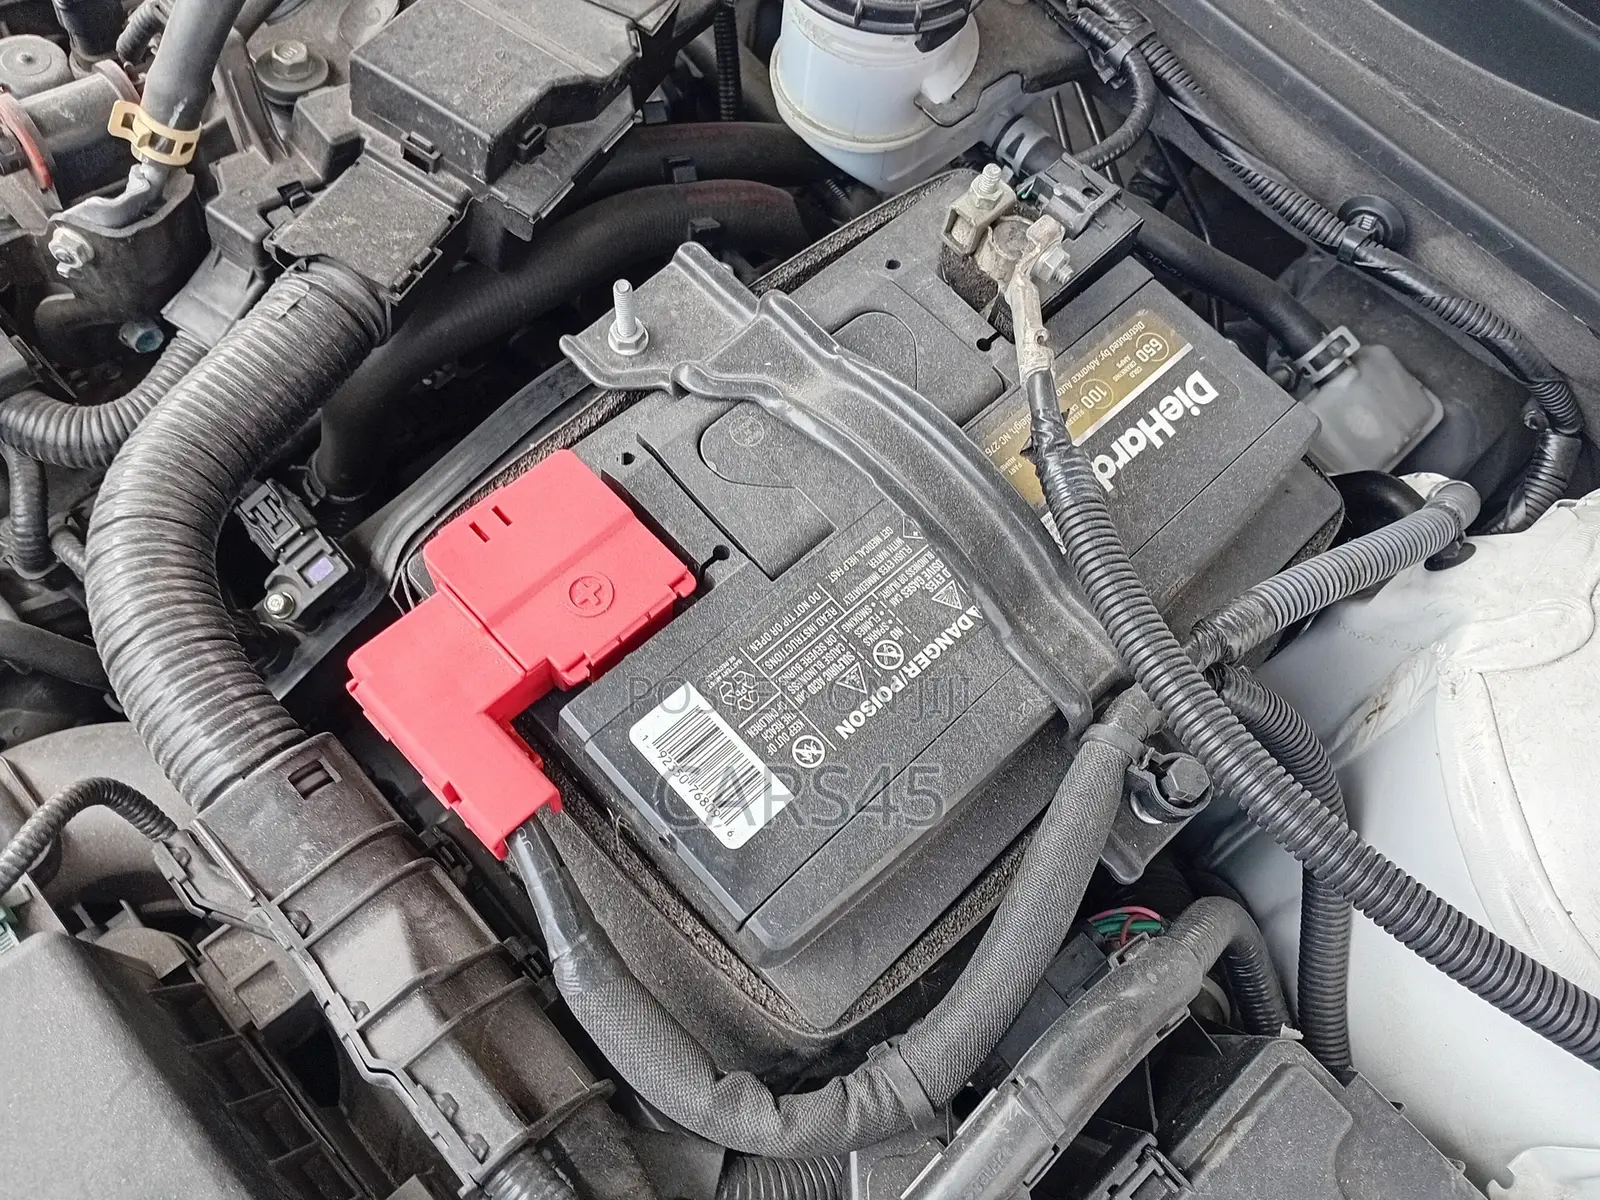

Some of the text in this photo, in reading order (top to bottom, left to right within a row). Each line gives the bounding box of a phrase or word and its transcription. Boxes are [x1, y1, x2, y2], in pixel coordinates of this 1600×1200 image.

[1107, 320, 1146, 354] Distributed
[1115, 354, 1131, 368] AMPS
[1134, 336, 1163, 364] 650
[1070, 356, 1101, 385] Advance
[1111, 359, 1137, 382] CRANKING
[1128, 365, 1142, 378] COLD
[1054, 379, 1074, 398] Auto
[1079, 382, 1107, 410] 100
[983, 411, 1034, 457] aleigh, NC 276
[1085, 368, 1220, 493] DieHard
[1007, 460, 1022, 475] PART
[878, 525, 894, 540] GET
[885, 535, 905, 553] WITH
[855, 534, 883, 559] MEDICAL
[840, 554, 859, 571] HELP
[904, 550, 935, 578] BLINDNESS
[920, 558, 945, 580] OSIVE
[840, 544, 913, 606] FLUSH EYES IMMEDIATELY
[896, 572, 909, 584] OR
[898, 574, 926, 599] GASES
[791, 599, 811, 617] NOT
[806, 590, 822, 604] DO
[888, 592, 904, 607] CAN
[779, 611, 796, 627] TIP
[814, 605, 838, 627] READ
[840, 603, 873, 633] SMOKING
[853, 612, 882, 638] FLAMES
[768, 621, 784, 636] OR
[822, 632, 838, 647] OR
[861, 621, 890, 647] SPARKS
[888, 625, 904, 641] NO
[798, 641, 827, 667] SEVERE
[785, 641, 846, 694] CAUSE BLINDNESS
[793, 650, 856, 705] SULFURIC ACID CAN
[833, 613, 975, 739] DANGER/POISON
[733, 685, 747, 698] Pb
[774, 699, 789, 713] OF
[760, 708, 797, 742] THE REACH
[763, 718, 806, 756] KEEP OUT OF
[657, 750, 690, 785] 92350
[688, 784, 721, 818] 76809
[726, 830, 735, 838] 6
